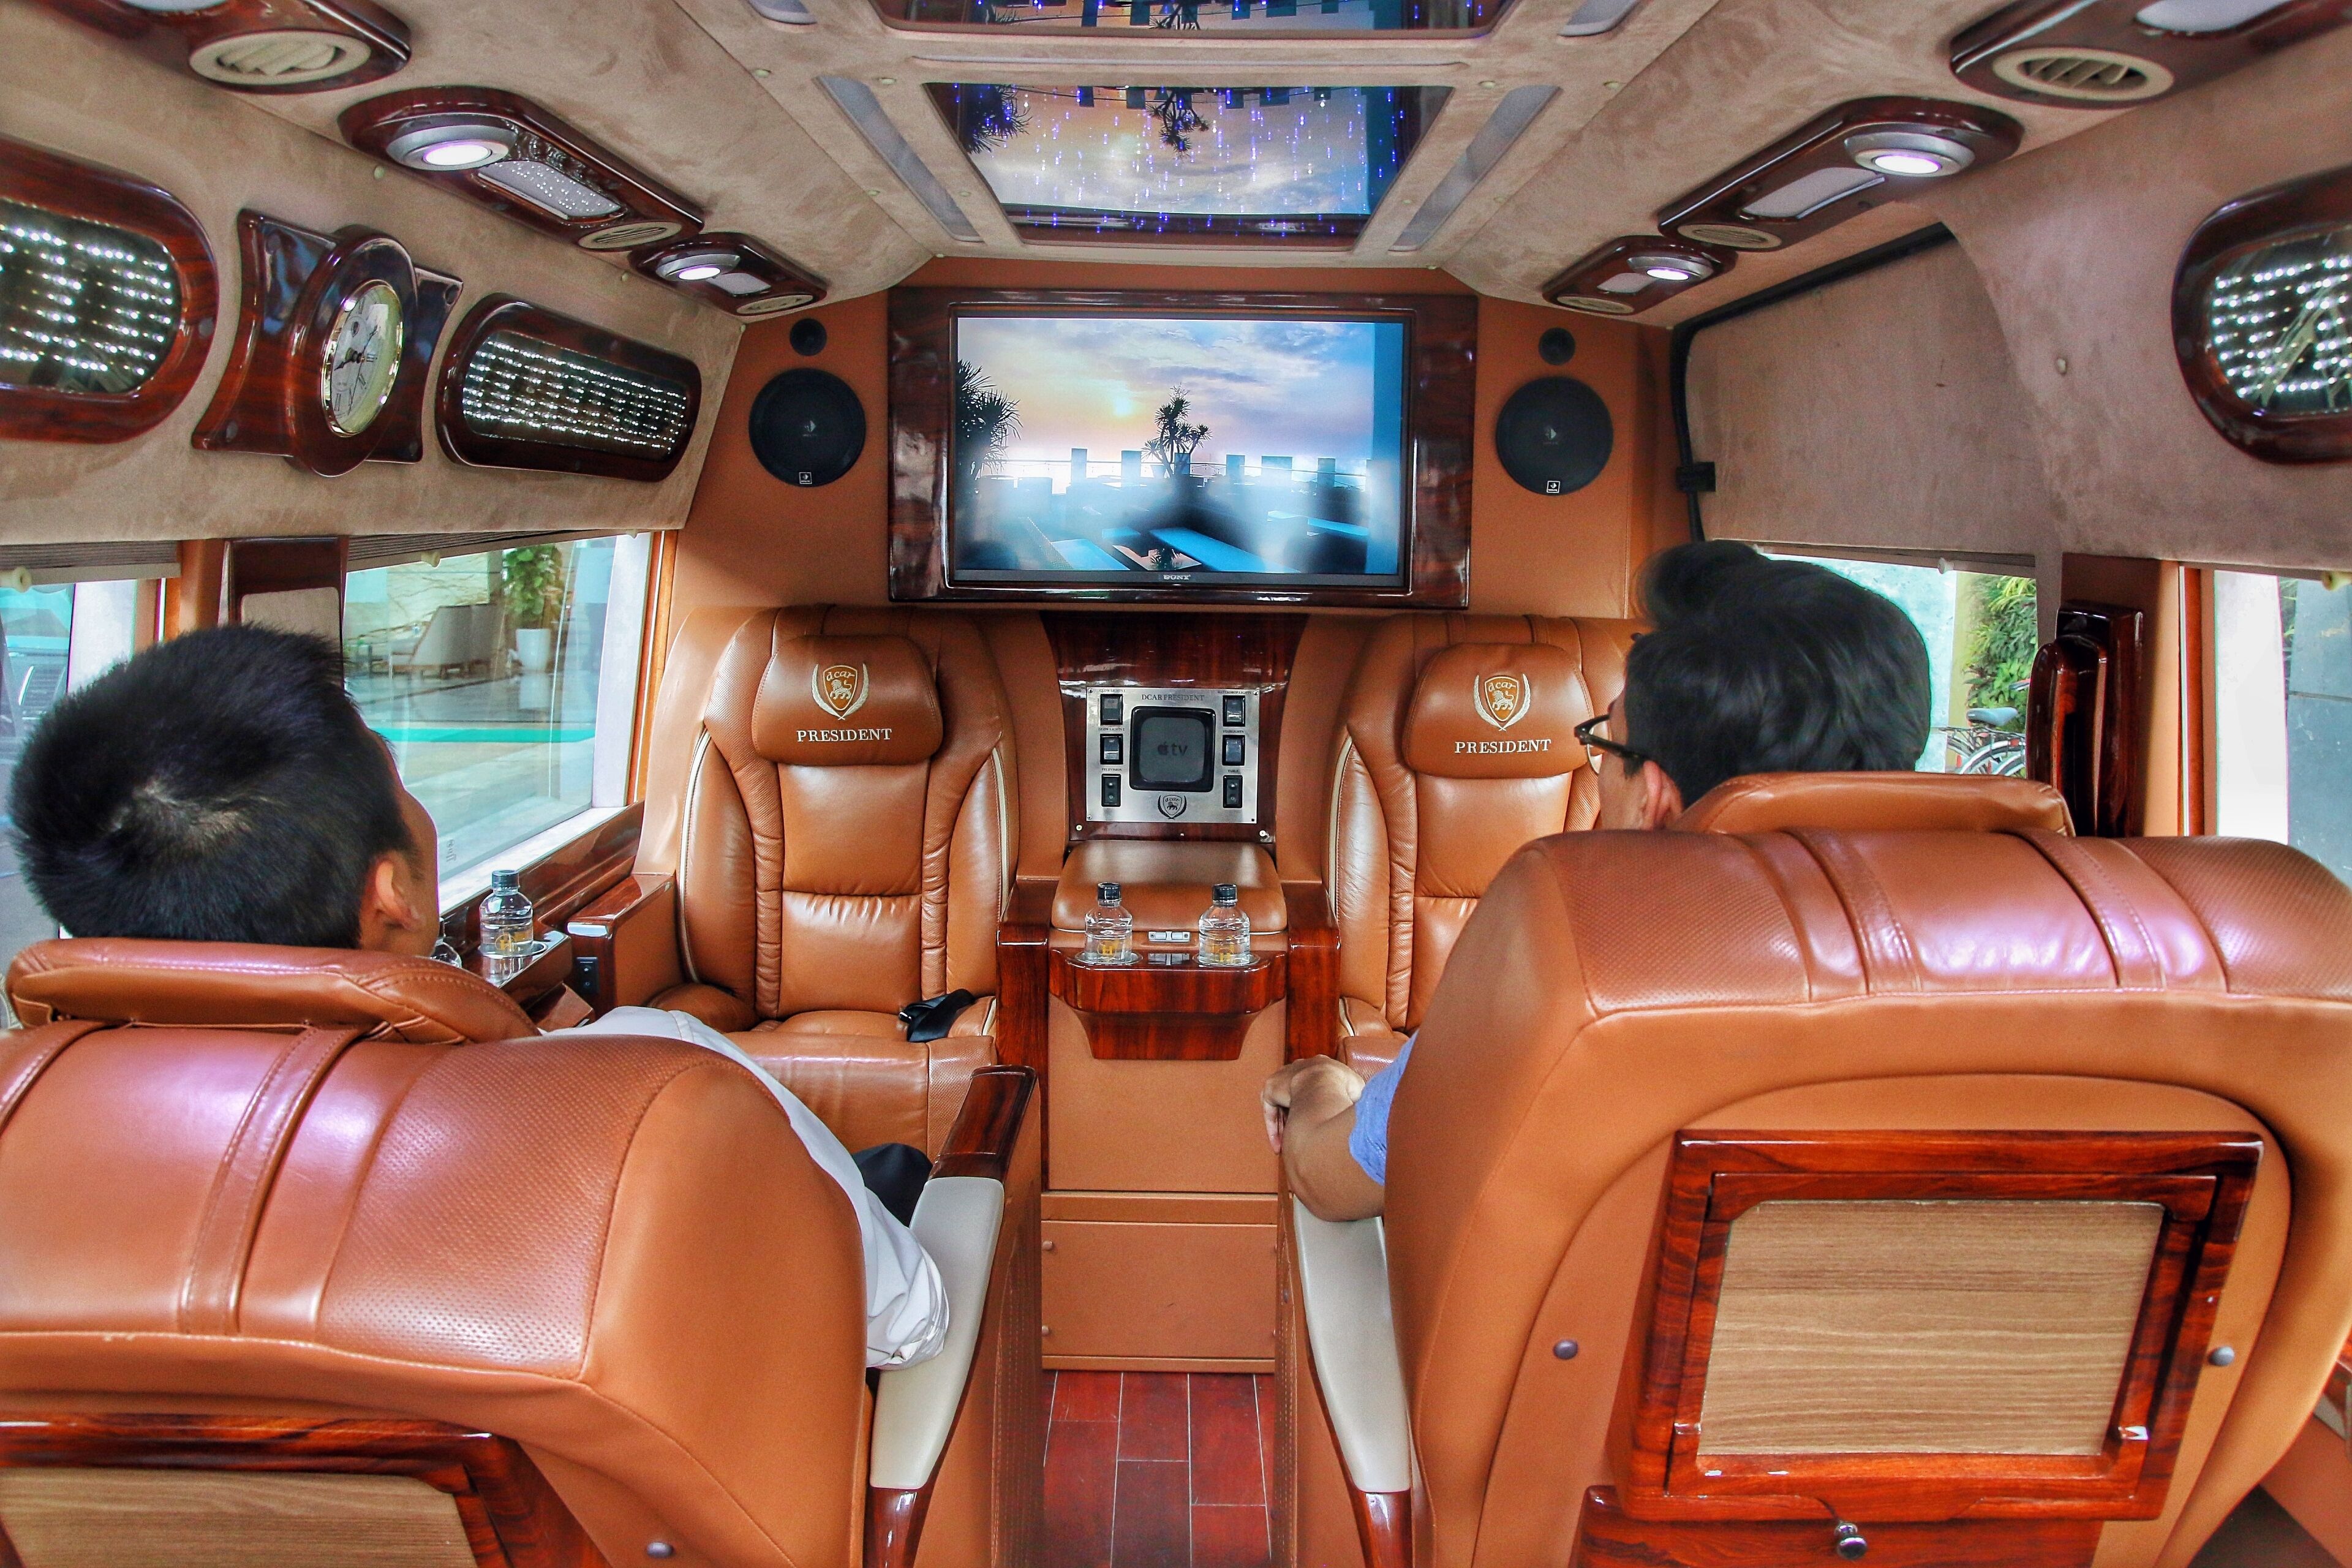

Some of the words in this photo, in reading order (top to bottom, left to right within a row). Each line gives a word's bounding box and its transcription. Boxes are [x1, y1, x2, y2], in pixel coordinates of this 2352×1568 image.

[826, 671, 855, 681] dcar
[1488, 682, 1517, 692] dcar
[796, 728, 892, 742] PRESIDENT
[1171, 742, 1188, 756] tv
[1455, 739, 1551, 754] PRESIDENT
